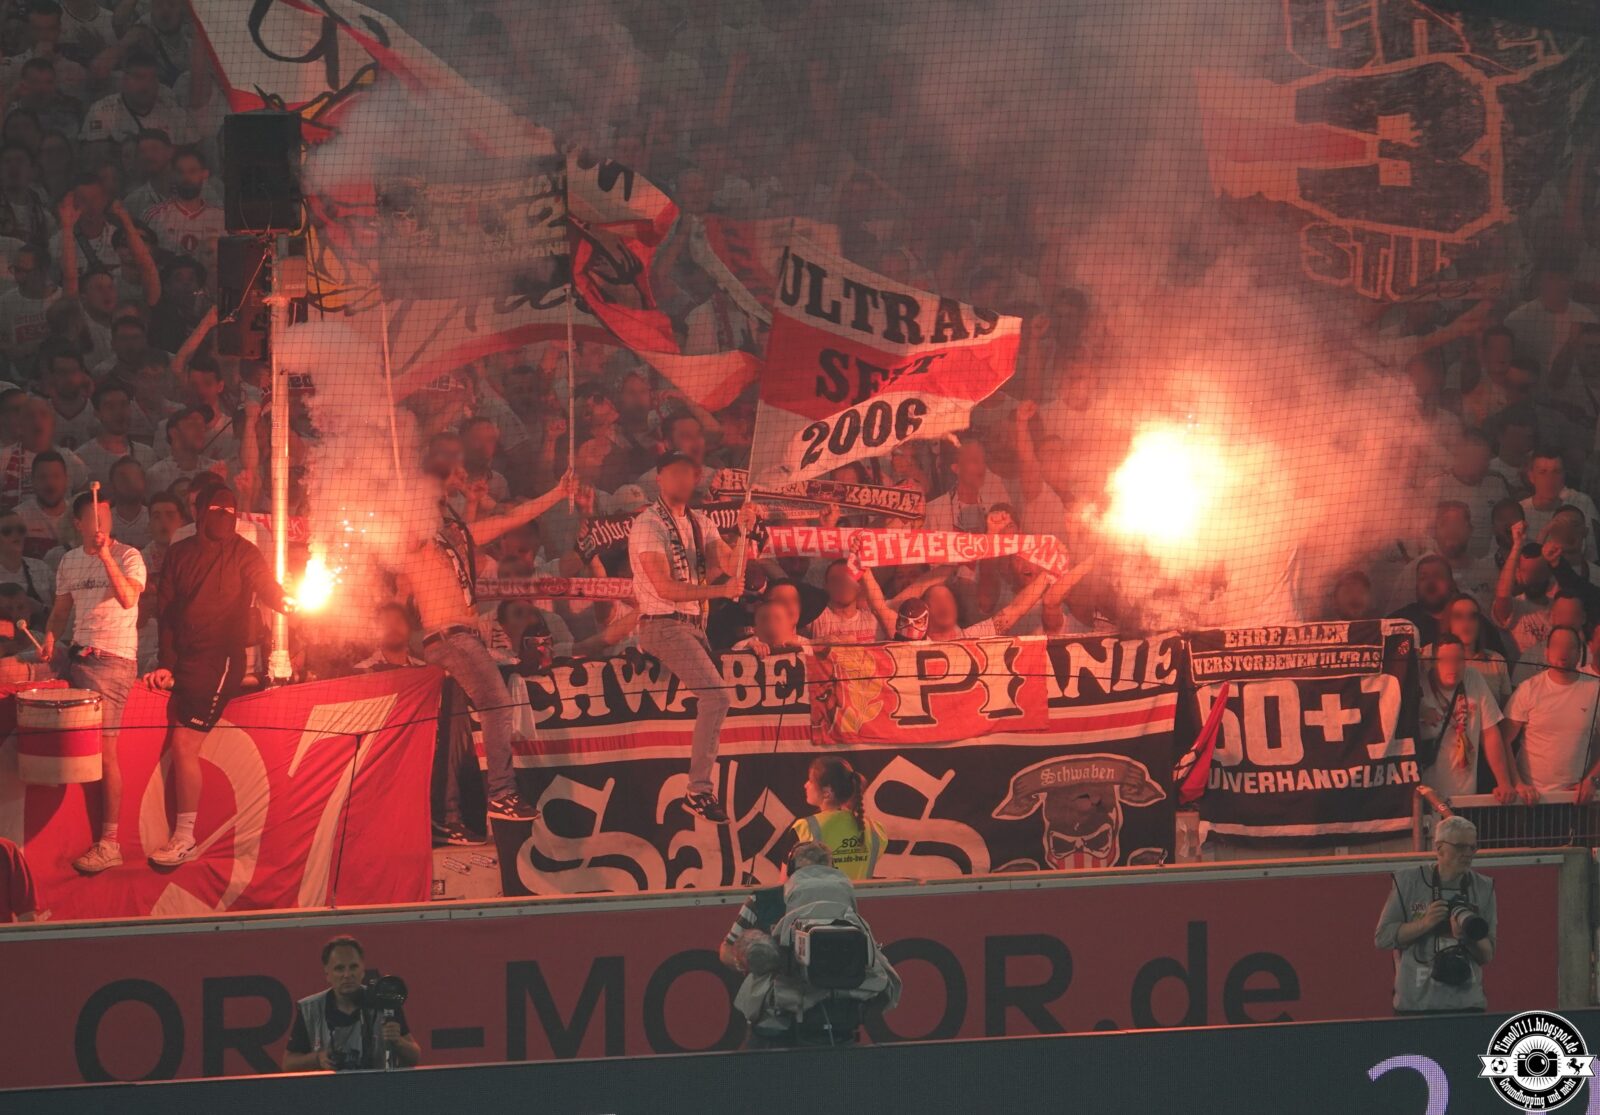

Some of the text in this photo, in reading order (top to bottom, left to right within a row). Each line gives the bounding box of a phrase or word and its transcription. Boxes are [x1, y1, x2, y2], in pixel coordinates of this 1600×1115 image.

[779, 245, 1000, 345] ULTRAS
[801, 397, 927, 470] 2006
[1224, 622, 1350, 648] EHRE ALLEN
[1194, 650, 1382, 675] VERSTORBENEN ULTRAS
[1196, 673, 1417, 767] 50+1
[1040, 764, 1116, 786] Schwaben
[1208, 760, 1421, 794] UNVERHANDELBAR
